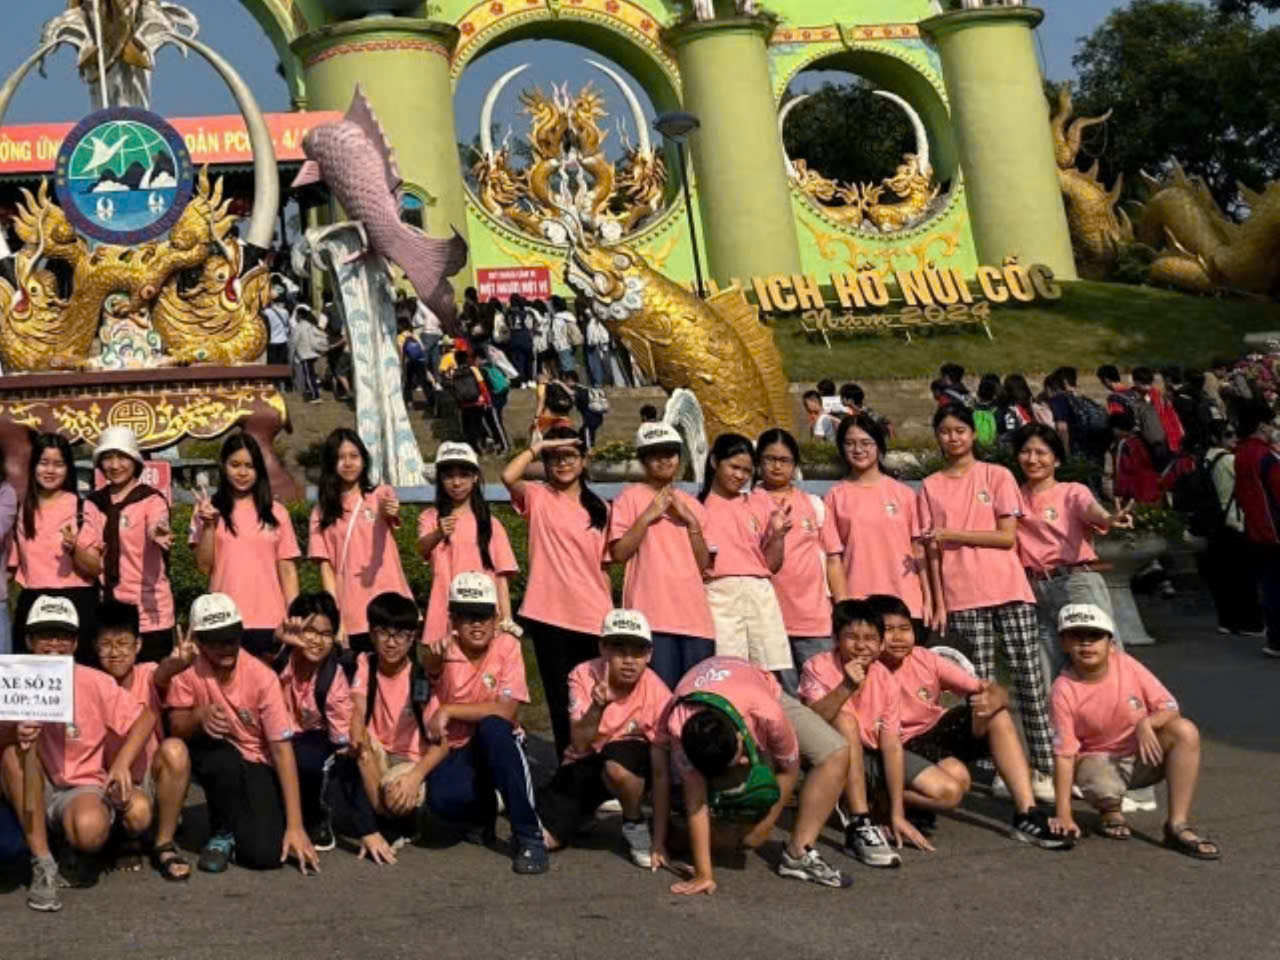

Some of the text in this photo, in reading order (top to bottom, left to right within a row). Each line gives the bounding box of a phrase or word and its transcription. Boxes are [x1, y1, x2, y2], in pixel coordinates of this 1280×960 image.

[900, 302, 991, 325] 2024
[1, 674, 62, 691] XE SỐ 22
